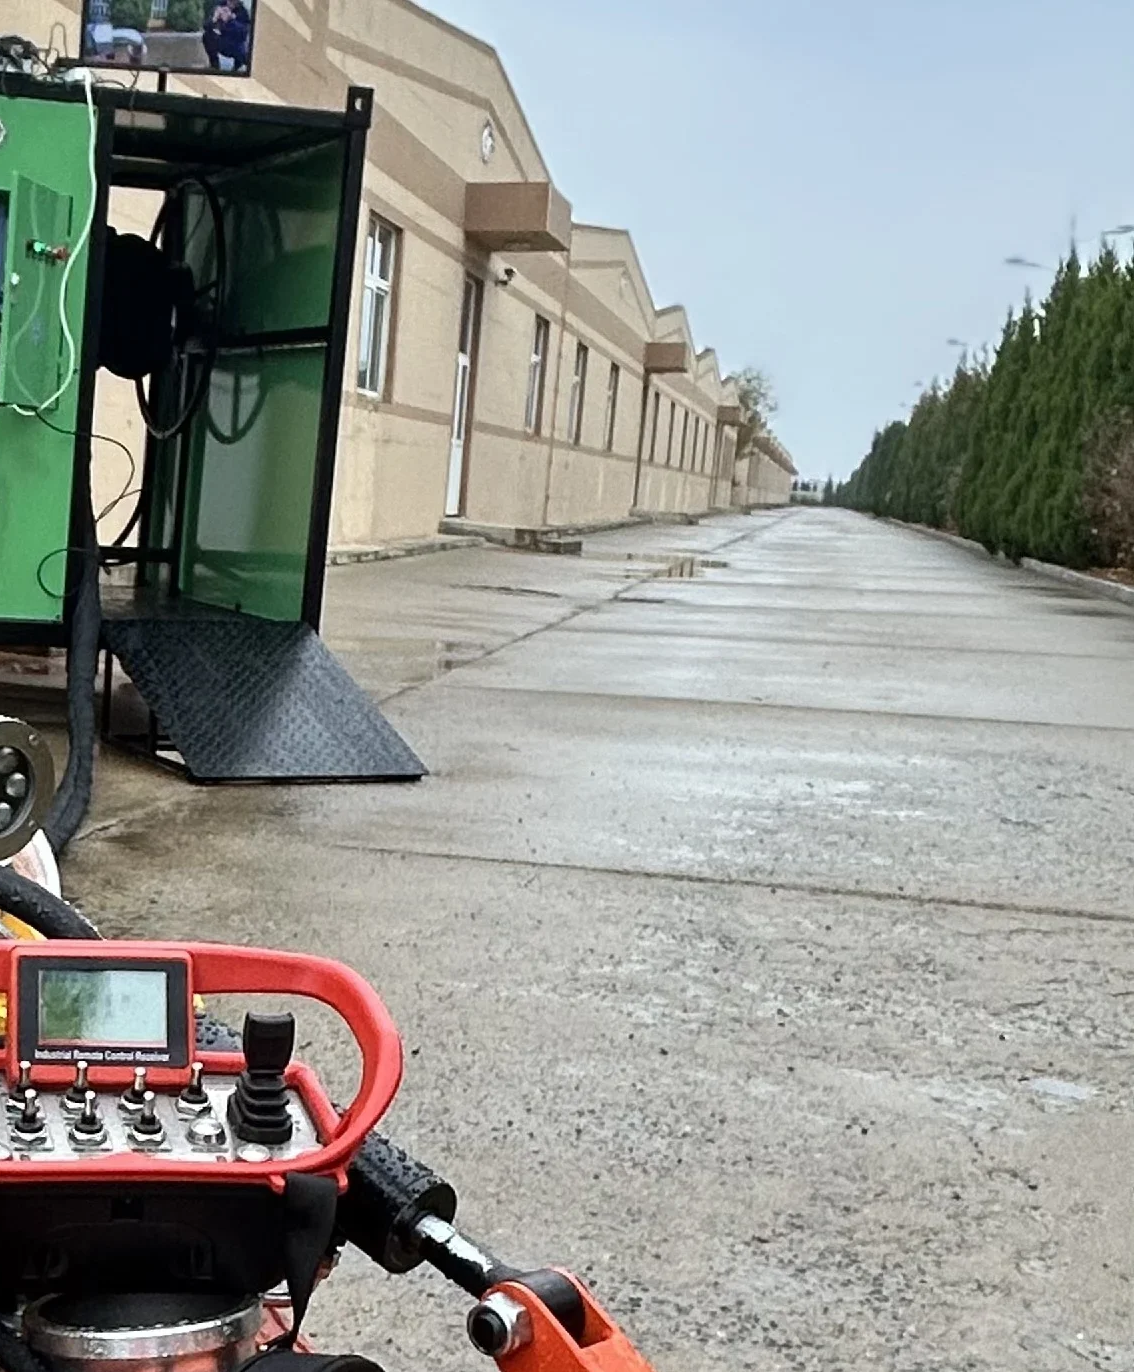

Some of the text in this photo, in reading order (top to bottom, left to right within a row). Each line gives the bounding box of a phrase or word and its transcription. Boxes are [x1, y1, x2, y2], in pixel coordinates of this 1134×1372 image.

[34, 1048, 170, 1062] Industrial Remote Control Receiver
